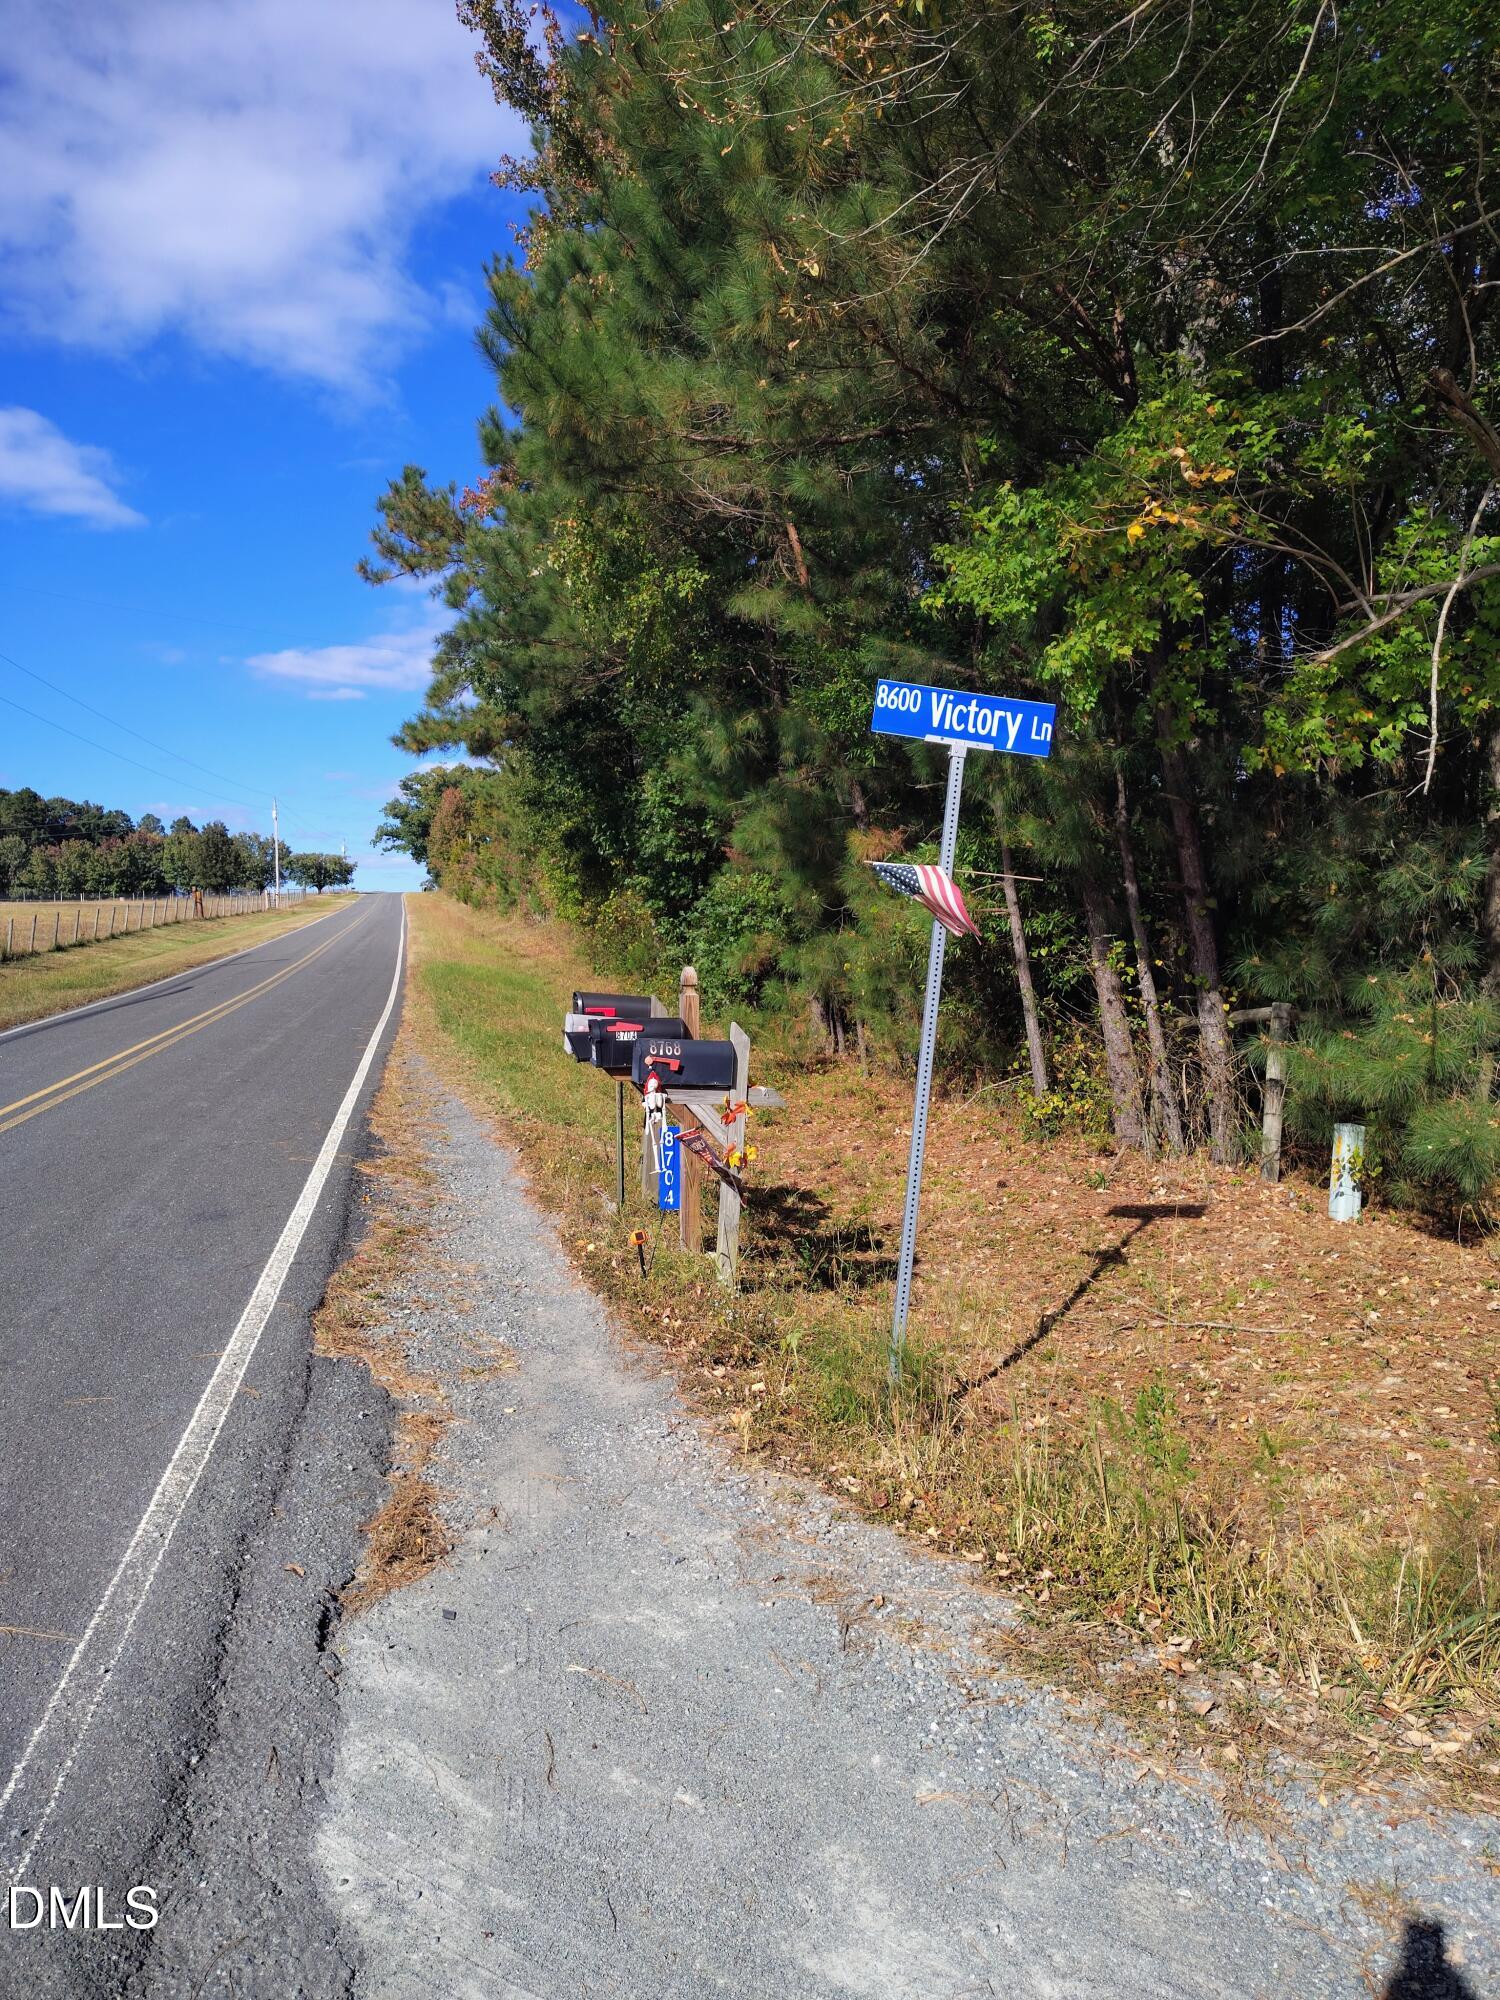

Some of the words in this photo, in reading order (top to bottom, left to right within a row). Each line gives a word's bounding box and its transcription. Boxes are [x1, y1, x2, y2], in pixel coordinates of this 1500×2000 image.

[877, 685, 922, 713] 8600
[931, 692, 1023, 749] Victory
[1031, 716, 1053, 742] Ln
[649, 1040, 681, 1056] 8768
[664, 1131, 674, 1206] 8704
